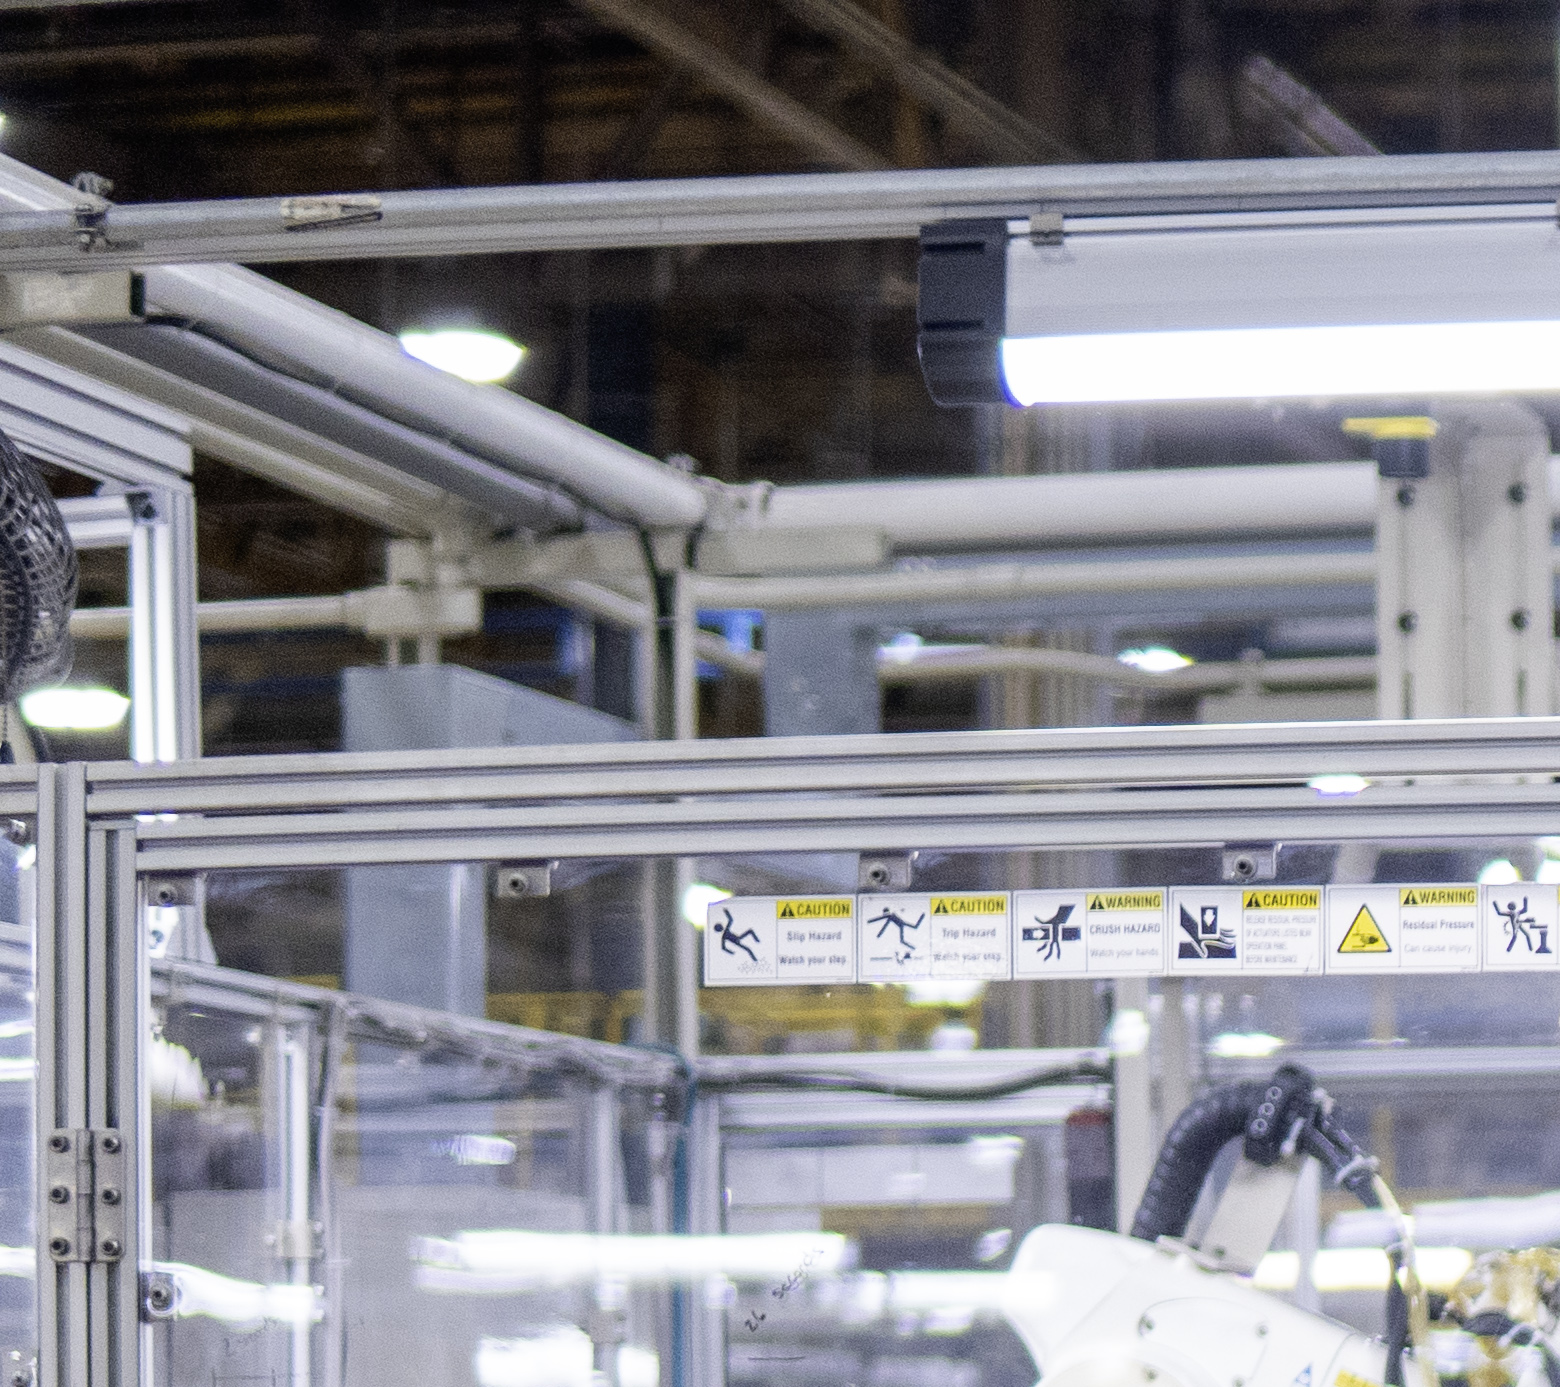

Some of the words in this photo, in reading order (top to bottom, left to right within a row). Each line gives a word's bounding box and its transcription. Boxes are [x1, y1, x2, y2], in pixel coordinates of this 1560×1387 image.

[1106, 894, 1160, 909] WARNING
[1263, 893, 1317, 907] CAUTION
[1419, 890, 1475, 904] WARNING
[796, 901, 850, 916] CAUTION
[950, 899, 1004, 914] CAUTION
[1089, 924, 1121, 934] CRUSH
[1124, 924, 1160, 934] HAZARD
[1403, 920, 1438, 930] Residual
[1440, 920, 1475, 929] Pressure
[787, 931, 807, 942] Slip
[810, 931, 842, 941] Hazard
[942, 928, 962, 939] Trip
[964, 928, 996, 937] Hazard
[780, 954, 806, 965] Watch
[808, 957, 827, 966] your
